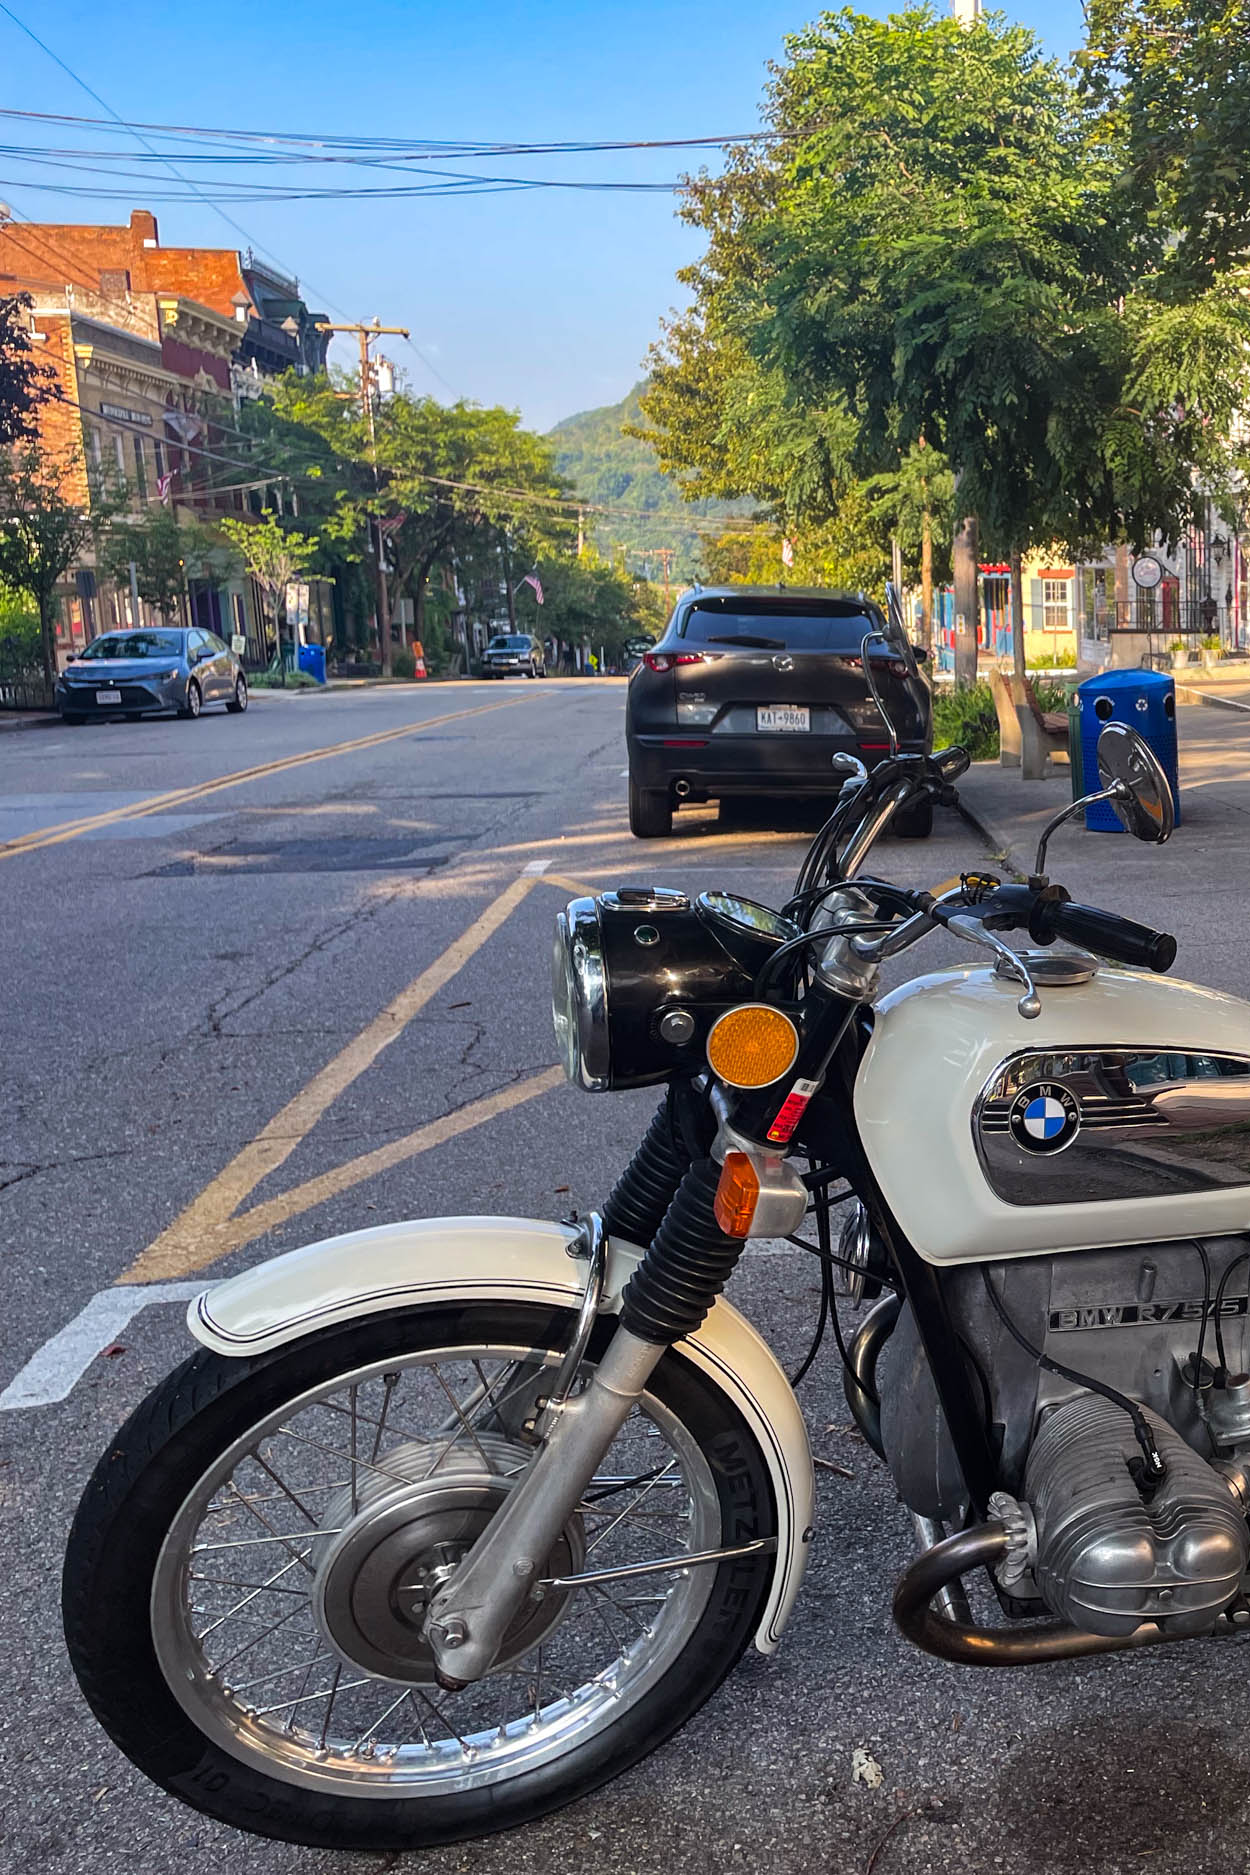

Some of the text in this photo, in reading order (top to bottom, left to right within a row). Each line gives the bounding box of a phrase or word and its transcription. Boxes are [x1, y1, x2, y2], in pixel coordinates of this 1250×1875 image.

[1017, 1085, 1074, 1109] BMW
[1058, 1299, 1240, 1330] BMW R75/5
[1151, 1451, 1163, 1469] NGK
[713, 1439, 758, 1631] METZLER
